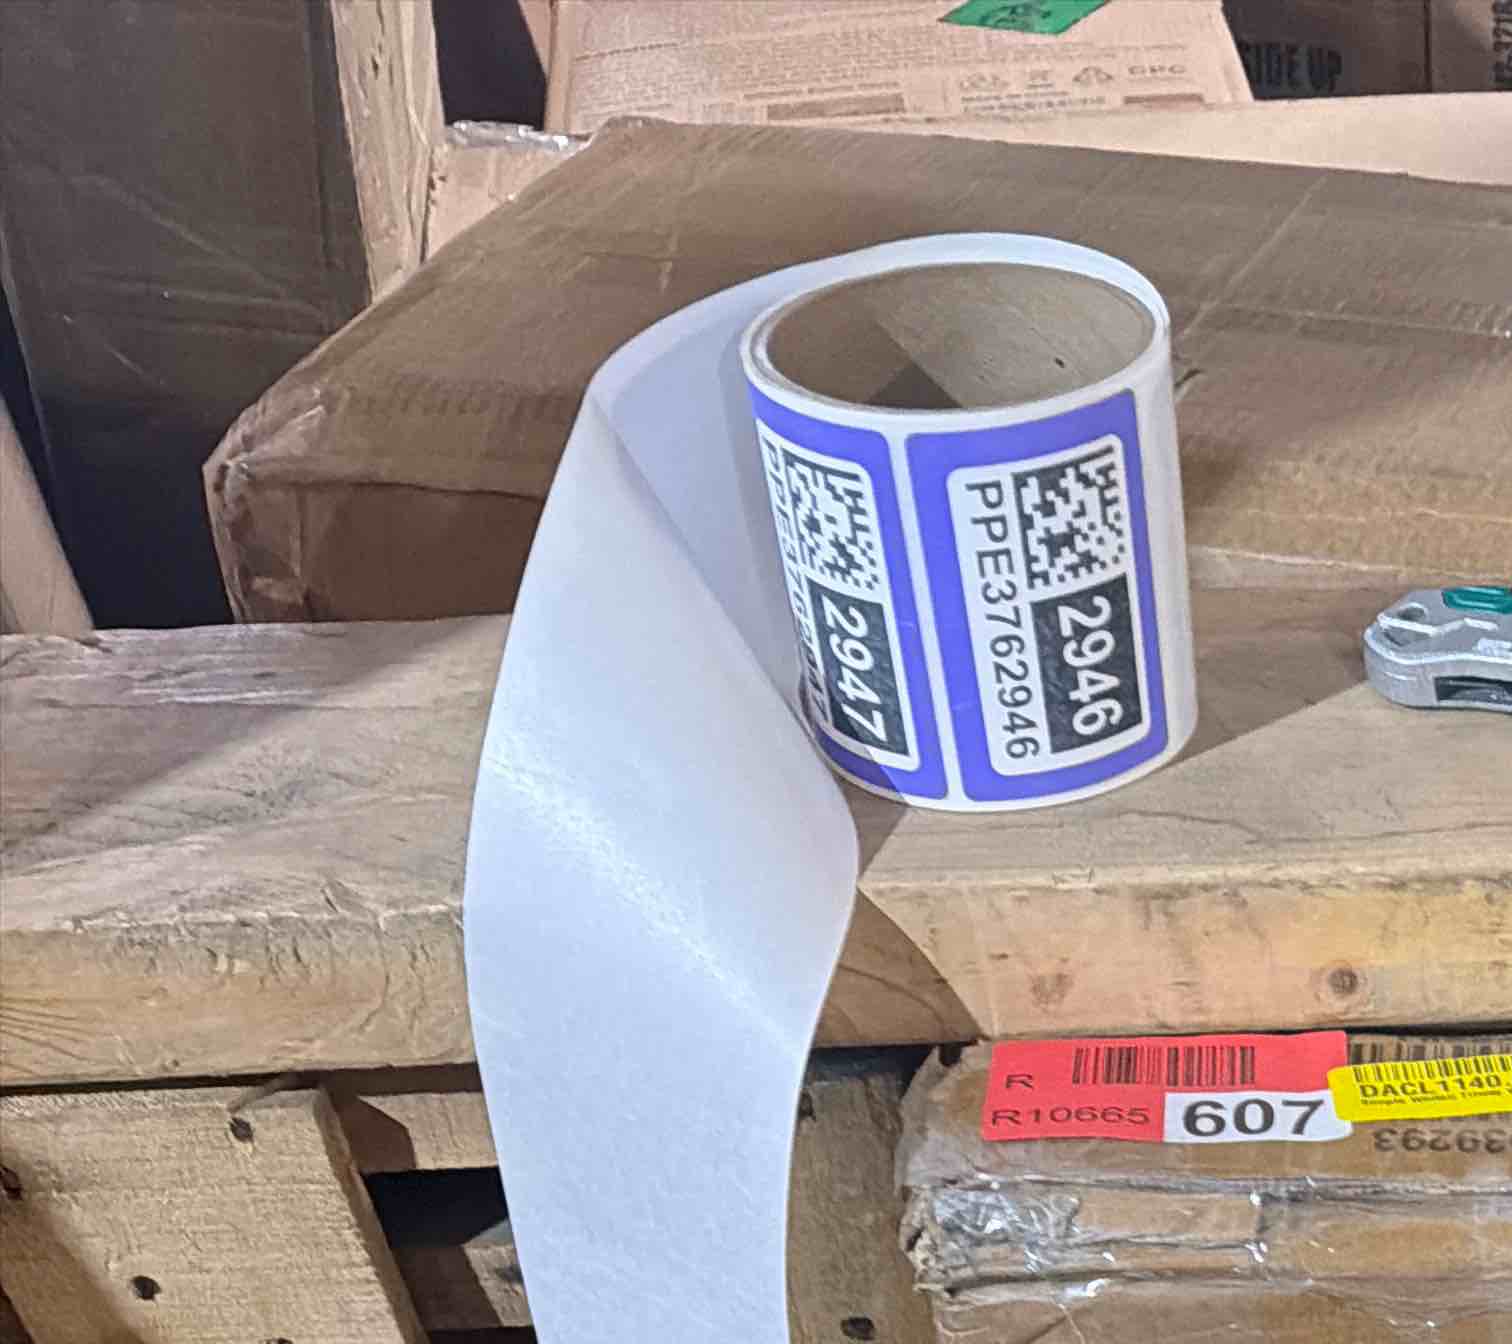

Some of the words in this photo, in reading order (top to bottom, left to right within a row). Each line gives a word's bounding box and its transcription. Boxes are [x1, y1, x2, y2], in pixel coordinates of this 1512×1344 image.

[964, 480, 1041, 760] PPE3762946
[1055, 594, 1123, 737] 2946
[818, 596, 889, 743] 2947
[990, 1105, 1152, 1127] R10665
[1004, 1073, 1035, 1090] R
[1182, 1098, 1327, 1137] 607
